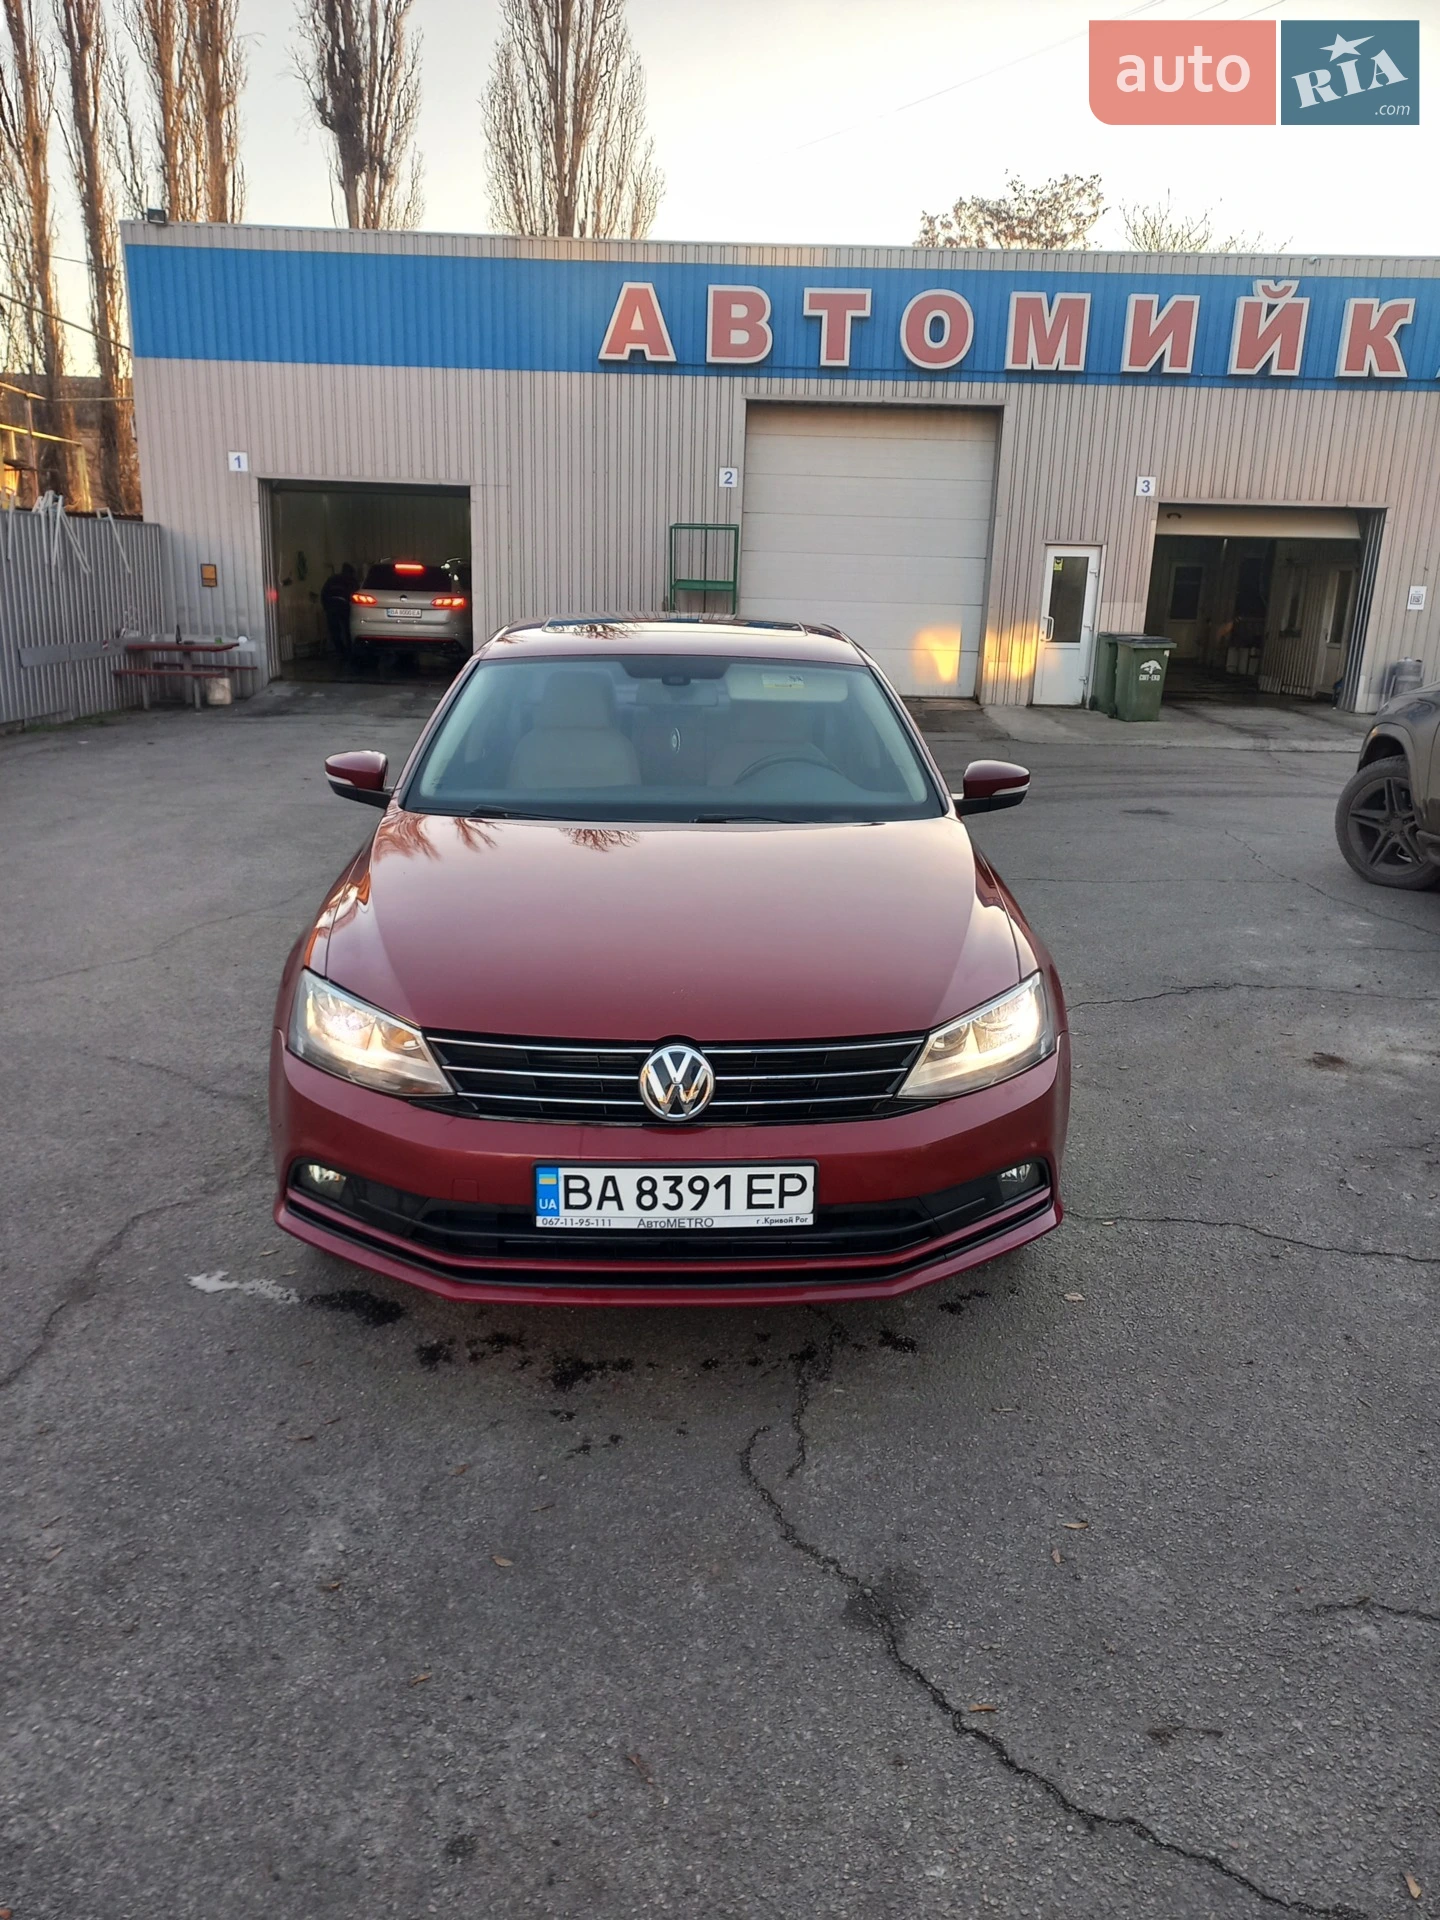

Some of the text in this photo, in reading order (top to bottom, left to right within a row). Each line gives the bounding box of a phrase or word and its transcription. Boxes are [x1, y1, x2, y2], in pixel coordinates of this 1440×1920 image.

[598, 279, 1440, 379] АВТОМИЙК
[233, 454, 241, 469] 1
[723, 470, 734, 485] 2
[1140, 479, 1151, 493] 3
[563, 1173, 808, 1212] BA 8391 EP
[539, 1199, 557, 1210] UA
[541, 1217, 612, 1227] 067-11-95-111
